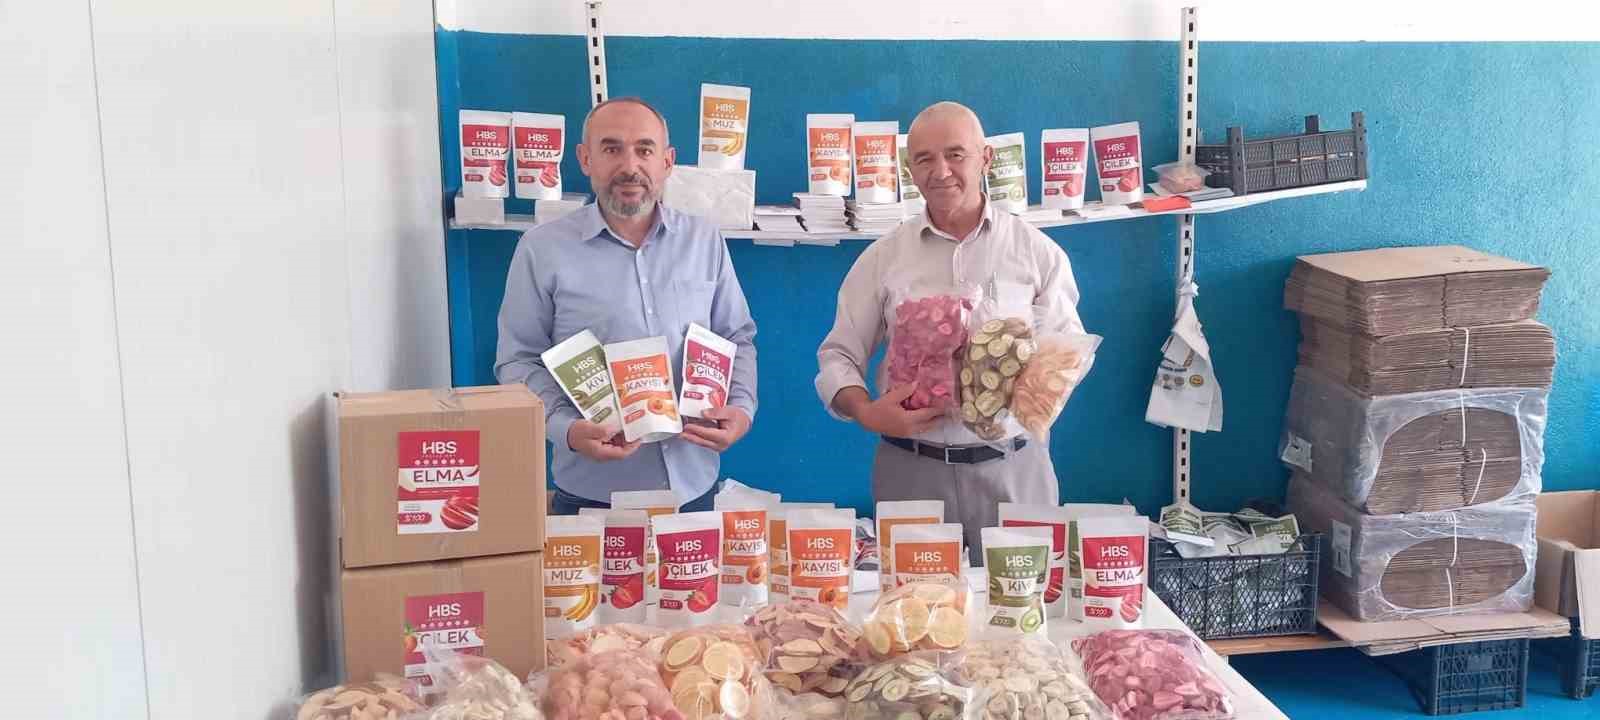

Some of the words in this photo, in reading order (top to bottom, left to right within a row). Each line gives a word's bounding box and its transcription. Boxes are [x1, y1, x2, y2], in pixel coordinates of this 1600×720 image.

[712, 119, 736, 129] MUZ
[476, 130, 497, 140] HBS
[527, 133, 550, 143] HBS
[472, 148, 500, 158] ELMA
[1055, 146, 1075, 156] HBS
[1106, 142, 1127, 154] HBS
[523, 150, 553, 159] ELMA
[572, 356, 597, 374] HBS
[422, 441, 458, 454] HBS
[413, 469, 466, 483] ELMA
[735, 518, 760, 529] HBS
[675, 539, 703, 552] HBS
[730, 540, 766, 552] KAYIS
[807, 536, 834, 549] HBS
[552, 544, 583, 557] HBS
[1101, 545, 1129, 557] HBS
[913, 551, 943, 563] HBS
[1006, 555, 1033, 567] HBS
[551, 569, 584, 581] MUZ
[1096, 569, 1136, 582] ELMA
[428, 603, 462, 618] HBS
